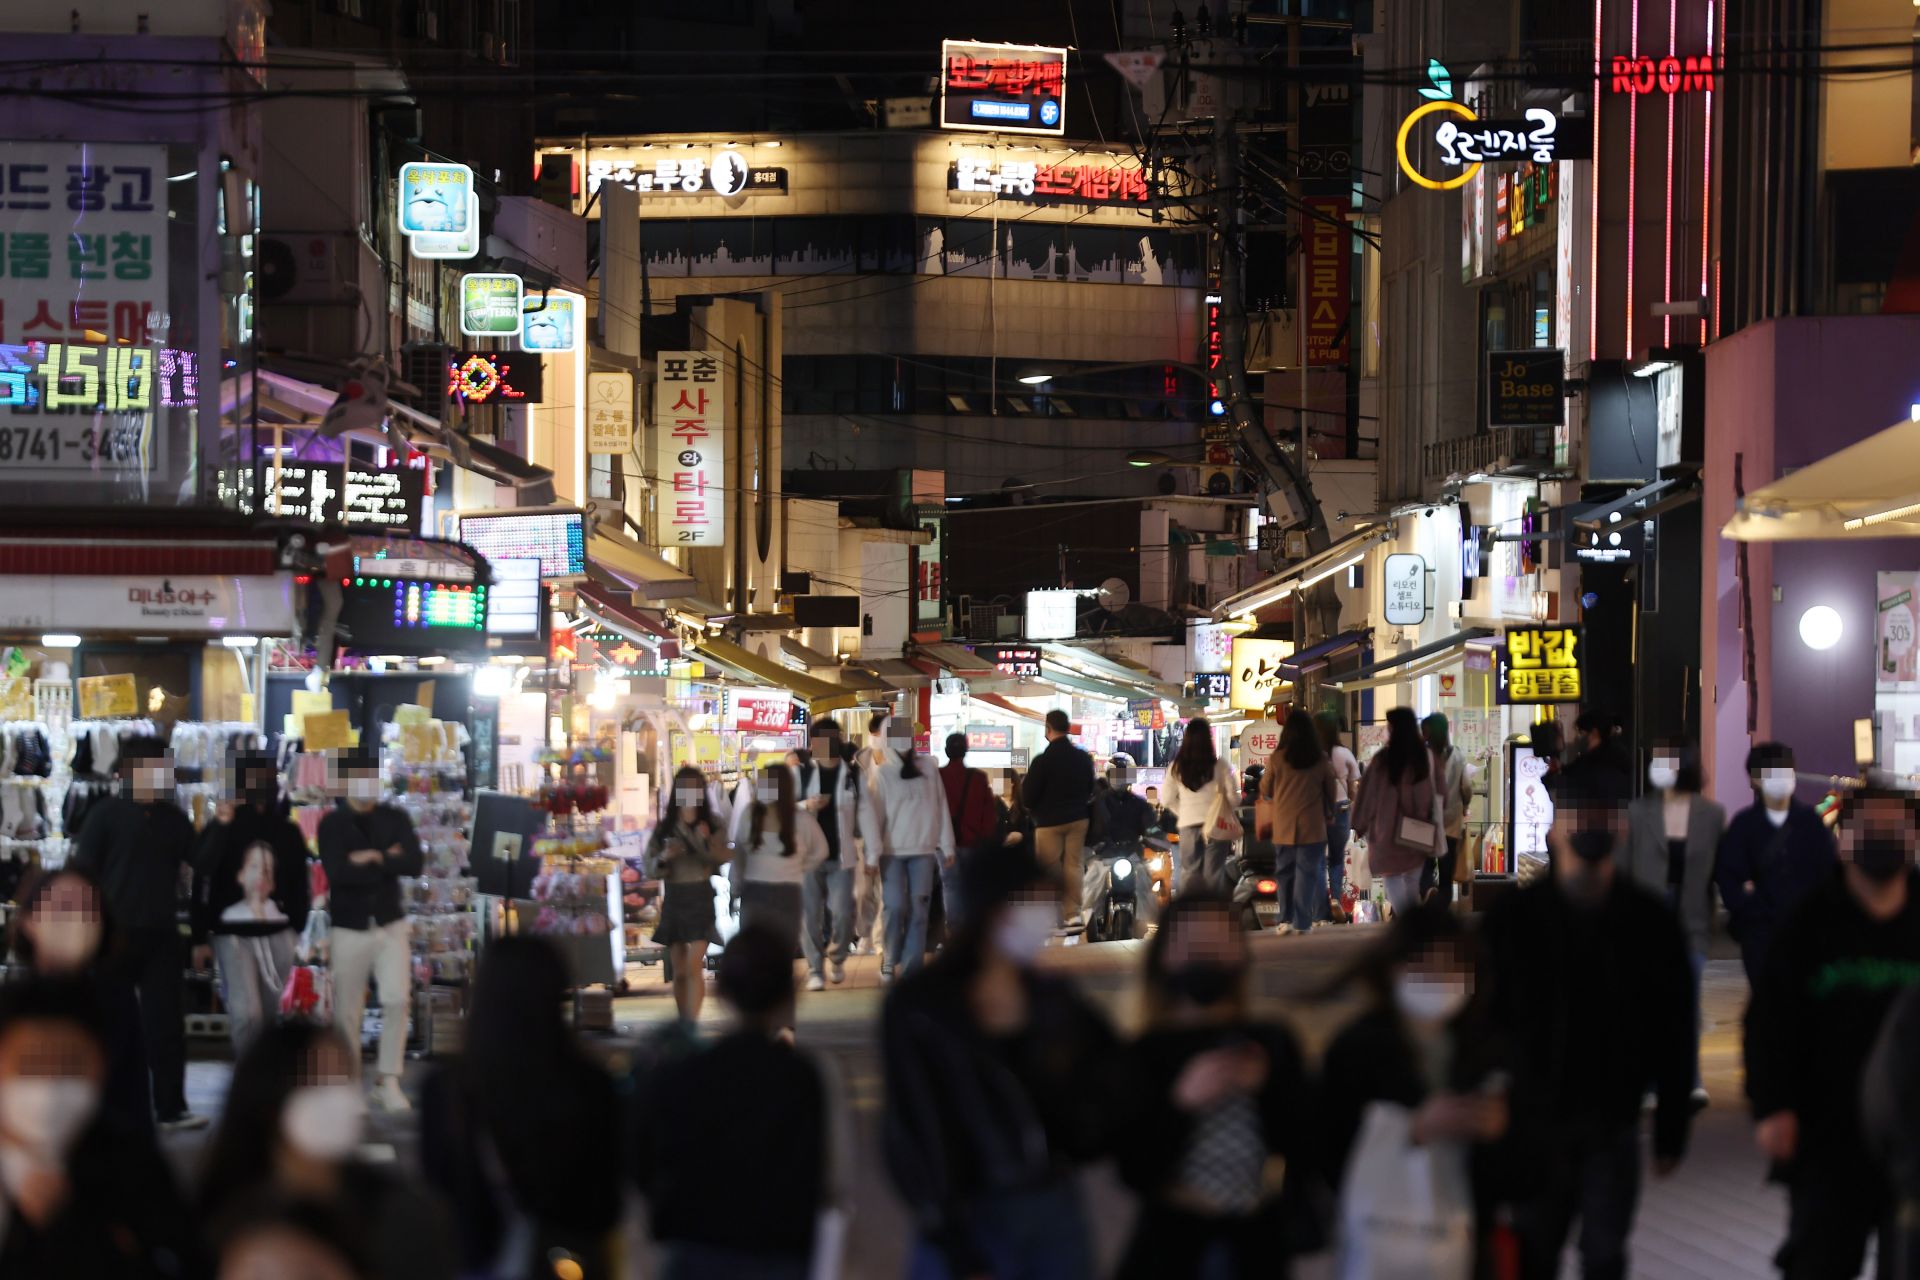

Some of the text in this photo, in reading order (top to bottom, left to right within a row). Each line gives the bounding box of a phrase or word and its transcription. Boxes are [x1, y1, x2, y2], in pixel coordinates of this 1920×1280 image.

[1612, 55, 1714, 94] ROOM
[1042, 105, 1057, 121] 5F
[0, 165, 154, 211] 드 광고
[754, 172, 777, 184] 홍대점
[0, 231, 153, 280] 품 런칭
[664, 357, 717, 382] 포춘
[1500, 380, 1555, 398] Base
[264, 466, 409, 523] 타로
[678, 530, 705, 542] 2F
[1392, 580, 1417, 591] 리모컨
[1396, 590, 1414, 601] 셀프
[1388, 601, 1422, 611] 스튜디오
[1507, 628, 1578, 669] 반값
[1511, 669, 1579, 696] 방탈출
